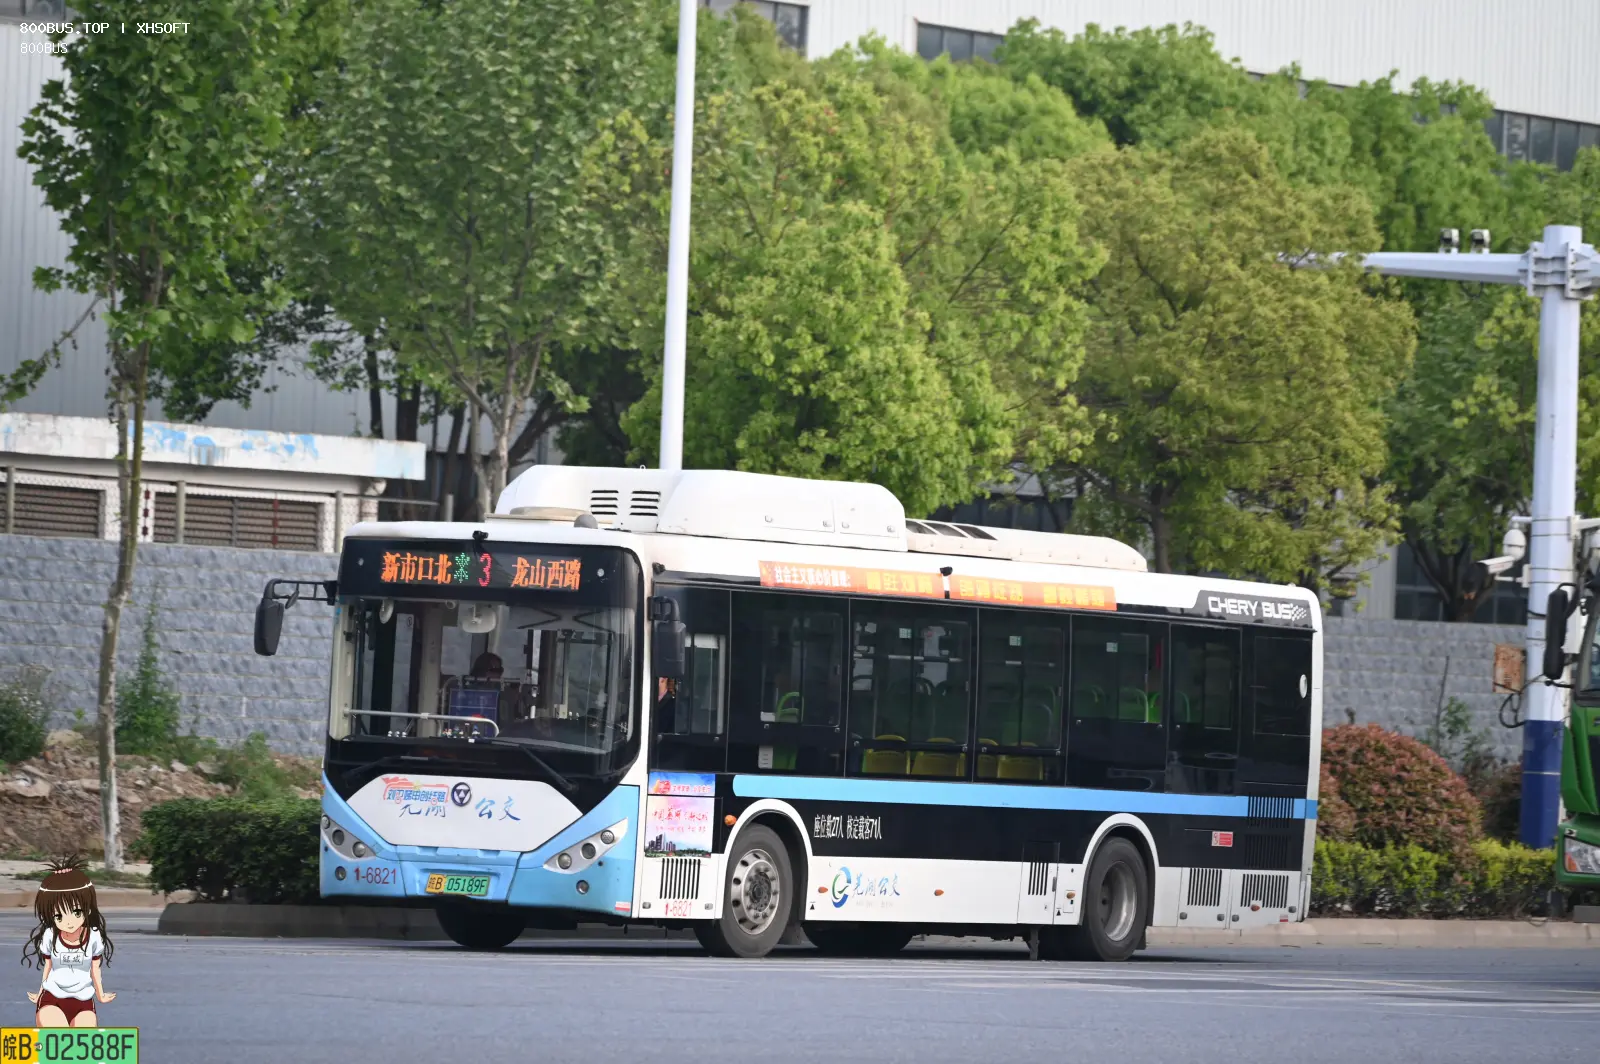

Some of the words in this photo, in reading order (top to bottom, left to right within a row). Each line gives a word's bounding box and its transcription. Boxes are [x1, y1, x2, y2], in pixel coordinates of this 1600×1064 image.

[380, 551, 452, 584] 新市口北
[478, 553, 492, 587] 3
[511, 556, 581, 590] 龙山西路
[1208, 596, 1258, 617] CHERY
[1261, 601, 1293, 620] BUS
[475, 796, 521, 821] 公交
[354, 866, 397, 885] 1-6821
[665, 900, 692, 917] 1-6821
